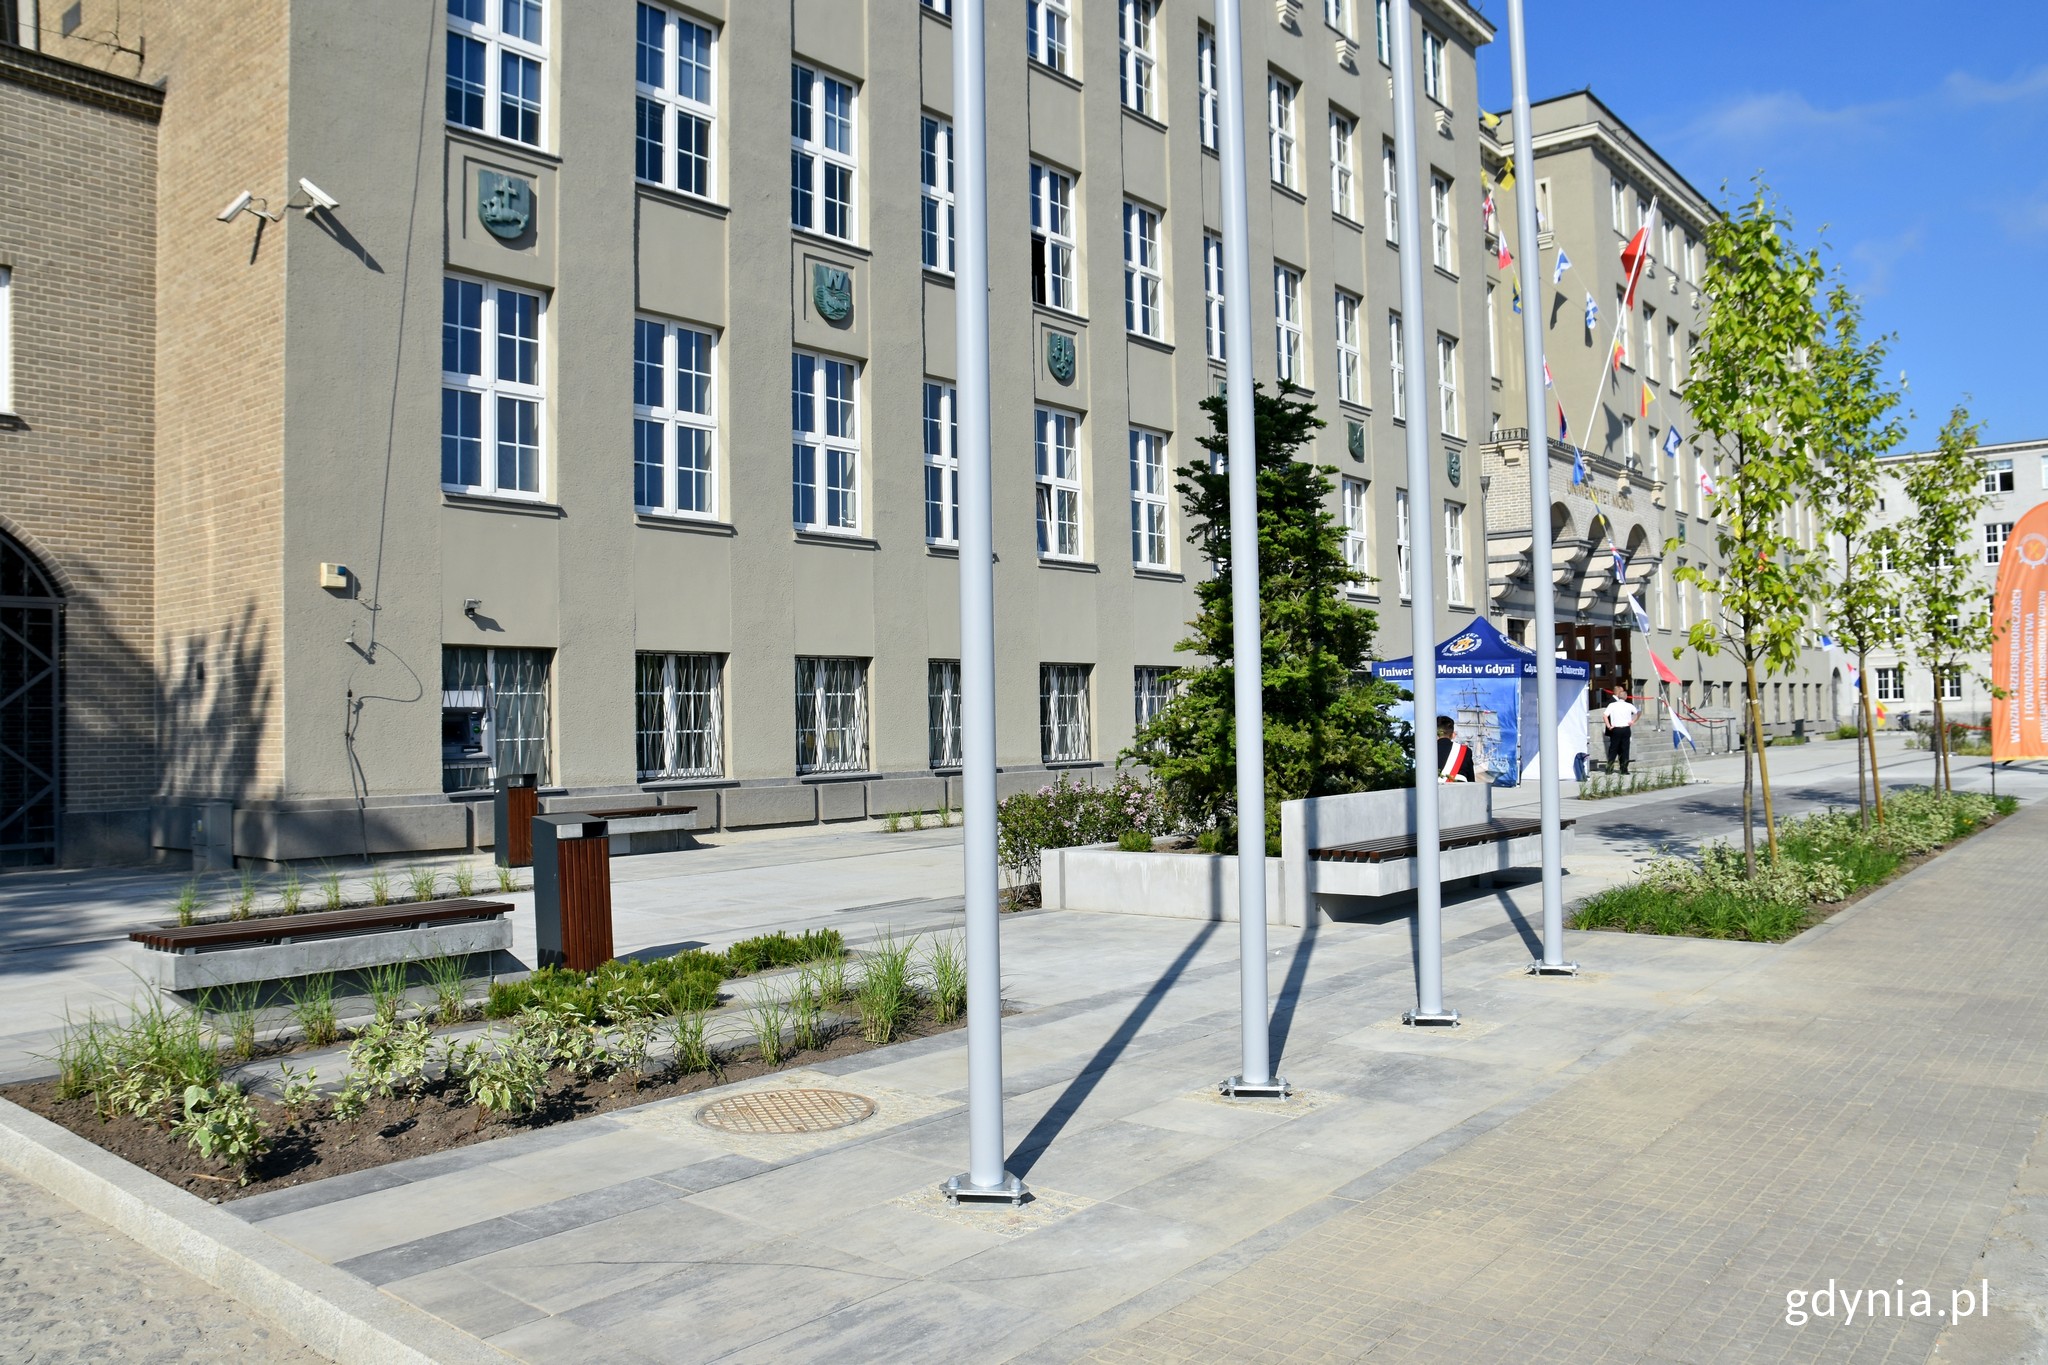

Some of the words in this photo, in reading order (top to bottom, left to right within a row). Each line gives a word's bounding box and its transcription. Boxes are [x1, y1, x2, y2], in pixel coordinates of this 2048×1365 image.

[2038, 619, 2047, 628] W
[1524, 663, 1537, 675] Gdyn
[1562, 665, 1586, 677] University
[2024, 613, 2035, 714] TOWAROZNAWSTWA
[1379, 667, 1414, 677] Uniwer
[1437, 664, 1472, 674] Morski
[1474, 666, 1483, 674] w
[1485, 664, 1515, 676] Gdyni
